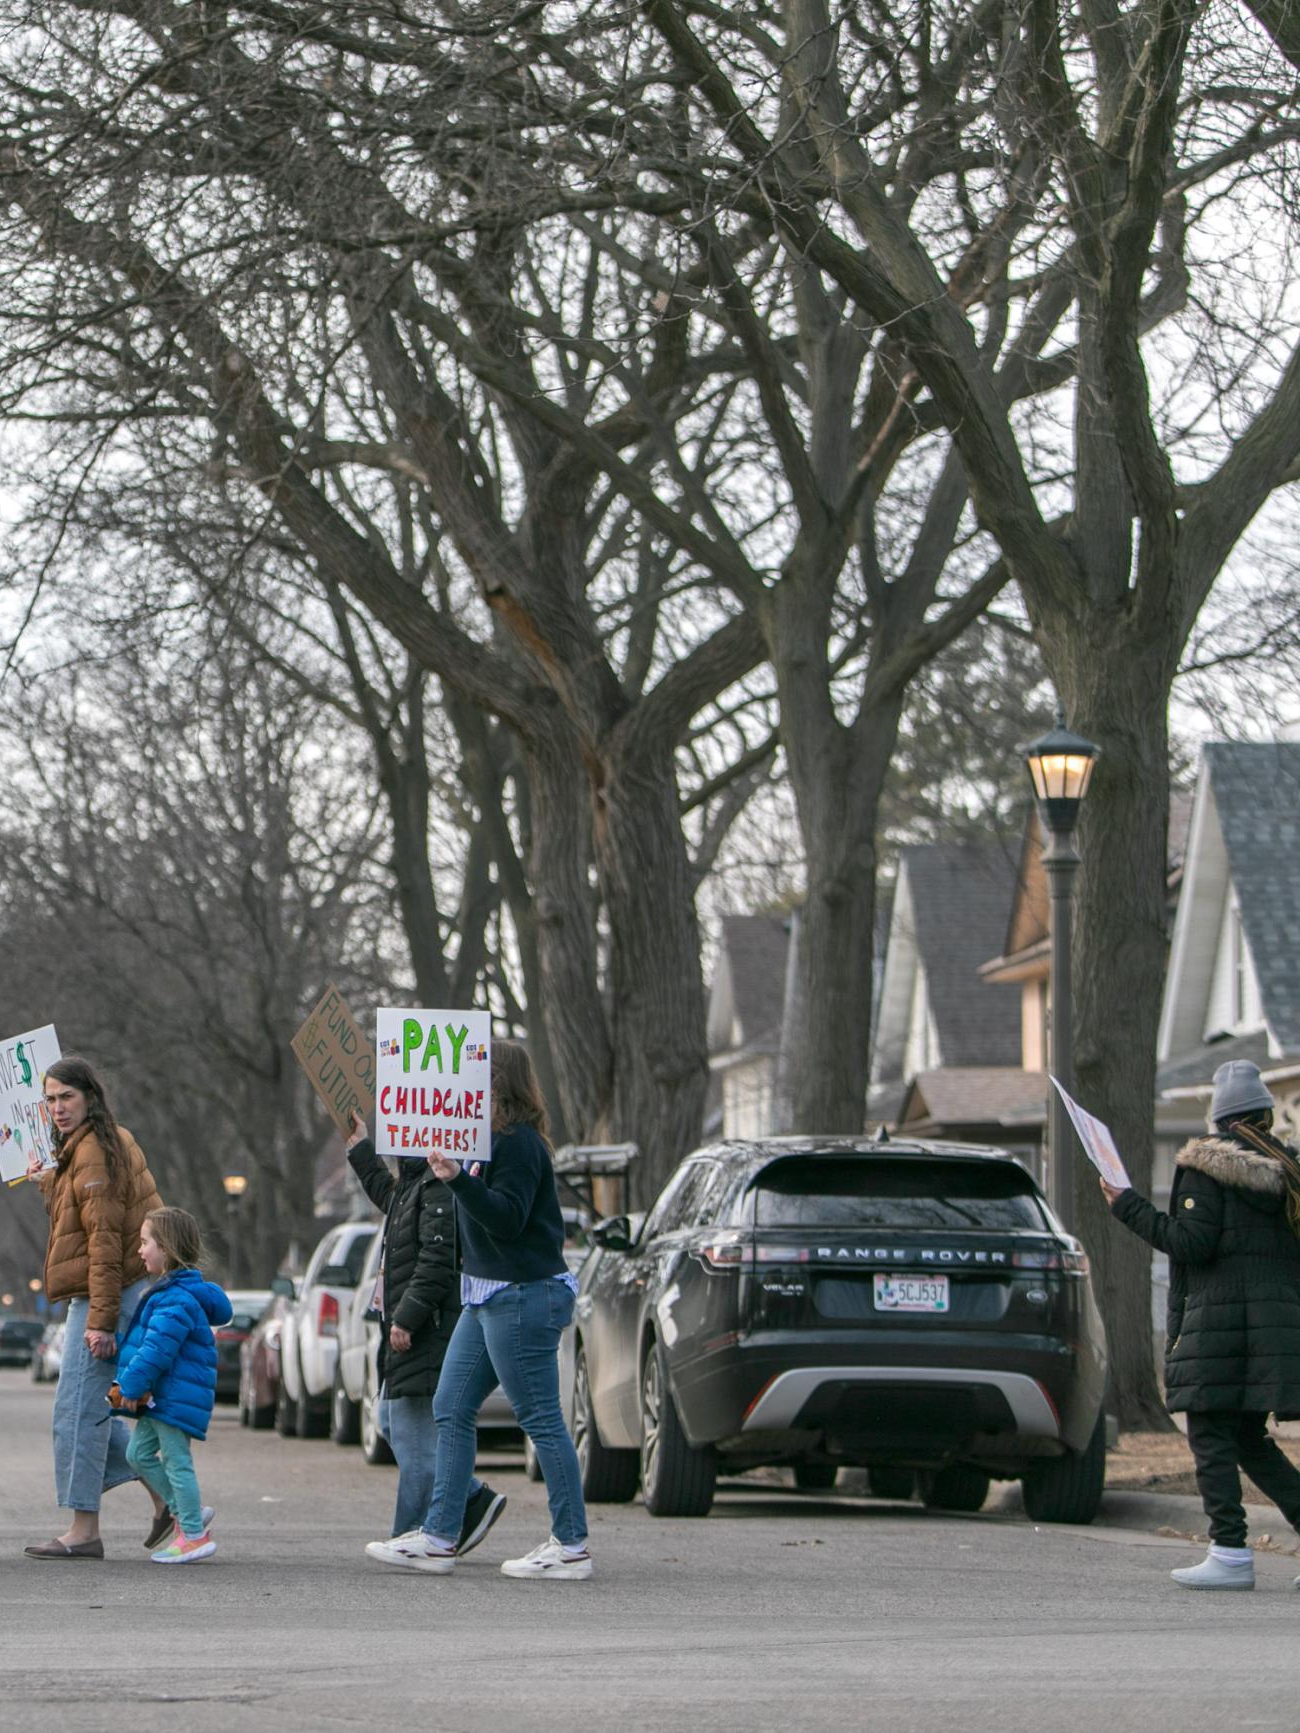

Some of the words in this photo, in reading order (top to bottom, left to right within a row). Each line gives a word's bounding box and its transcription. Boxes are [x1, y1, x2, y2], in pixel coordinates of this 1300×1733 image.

[320, 991, 358, 1055] FUND
[402, 1017, 468, 1074] PAY
[10, 1099, 25, 1125] IN
[380, 1085, 484, 1119] CHILDCARE
[387, 1123, 477, 1152] TEACHERS!
[817, 1247, 905, 1259] RANGE
[921, 1250, 1006, 1263] ROVER
[898, 1282, 946, 1302] 5CJ537
